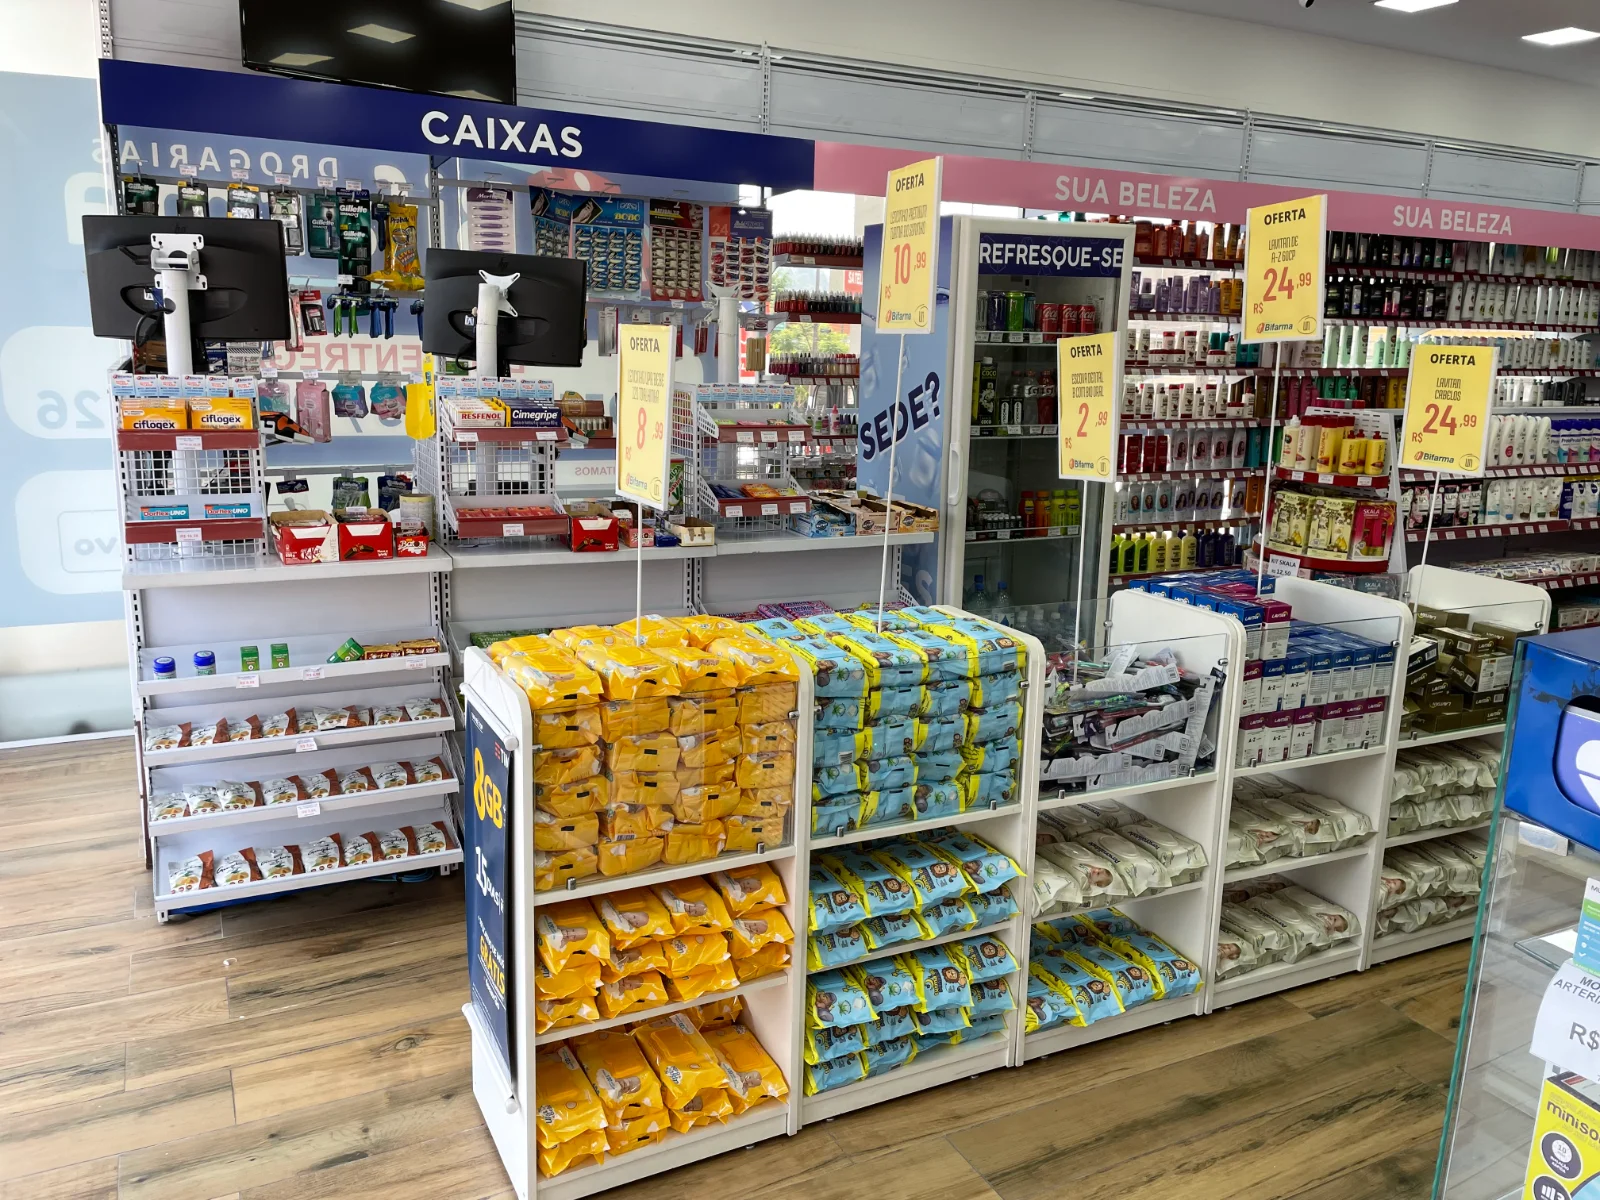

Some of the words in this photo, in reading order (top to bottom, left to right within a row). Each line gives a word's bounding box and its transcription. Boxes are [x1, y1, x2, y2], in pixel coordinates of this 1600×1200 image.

[421, 111, 583, 158] CAIXAS
[895, 173, 925, 193] OFERTA
[1055, 175, 1110, 205] SUA
[1118, 181, 1217, 213] BELEZA
[339, 205, 368, 214] Gillette
[1264, 208, 1306, 226] OFERTA
[1393, 204, 1433, 229] SUA
[1440, 209, 1512, 236] BELEZA
[711, 223, 729, 237] 24
[1268, 237, 1290, 251] LAVITAN
[1291, 235, 1299, 247] DE
[894, 243, 911, 285] 10
[979, 242, 1124, 270] REFRESQUE-SE
[1271, 251, 1281, 263] A-Z
[1253, 302, 1264, 315] R$
[1263, 266, 1294, 302] 24
[1264, 322, 1293, 331] Bifarma
[630, 336, 660, 353] OFERTA
[1070, 344, 1103, 358] OFERTA
[1430, 353, 1476, 366] OFERTA
[1436, 377, 1462, 389] LAVITAN
[1434, 390, 1462, 401] CABELOS
[133, 419, 176, 429] ciflogex
[201, 414, 241, 424] ciflogex
[512, 410, 558, 421] Cimegripe
[860, 371, 940, 461] SEDE?
[1411, 431, 1423, 444] R$
[1423, 403, 1457, 436] 24
[637, 407, 647, 449] 8
[1065, 437, 1073, 449] R$
[1077, 403, 1089, 437] 2
[1074, 460, 1094, 469] Bifarma
[1423, 452, 1454, 464] Bifarma
[1279, 559, 1297, 568] SKALA
[473, 746, 503, 830] 8GB
[1569, 1021, 1600, 1051] R$
[1546, 1100, 1600, 1144] miniso
